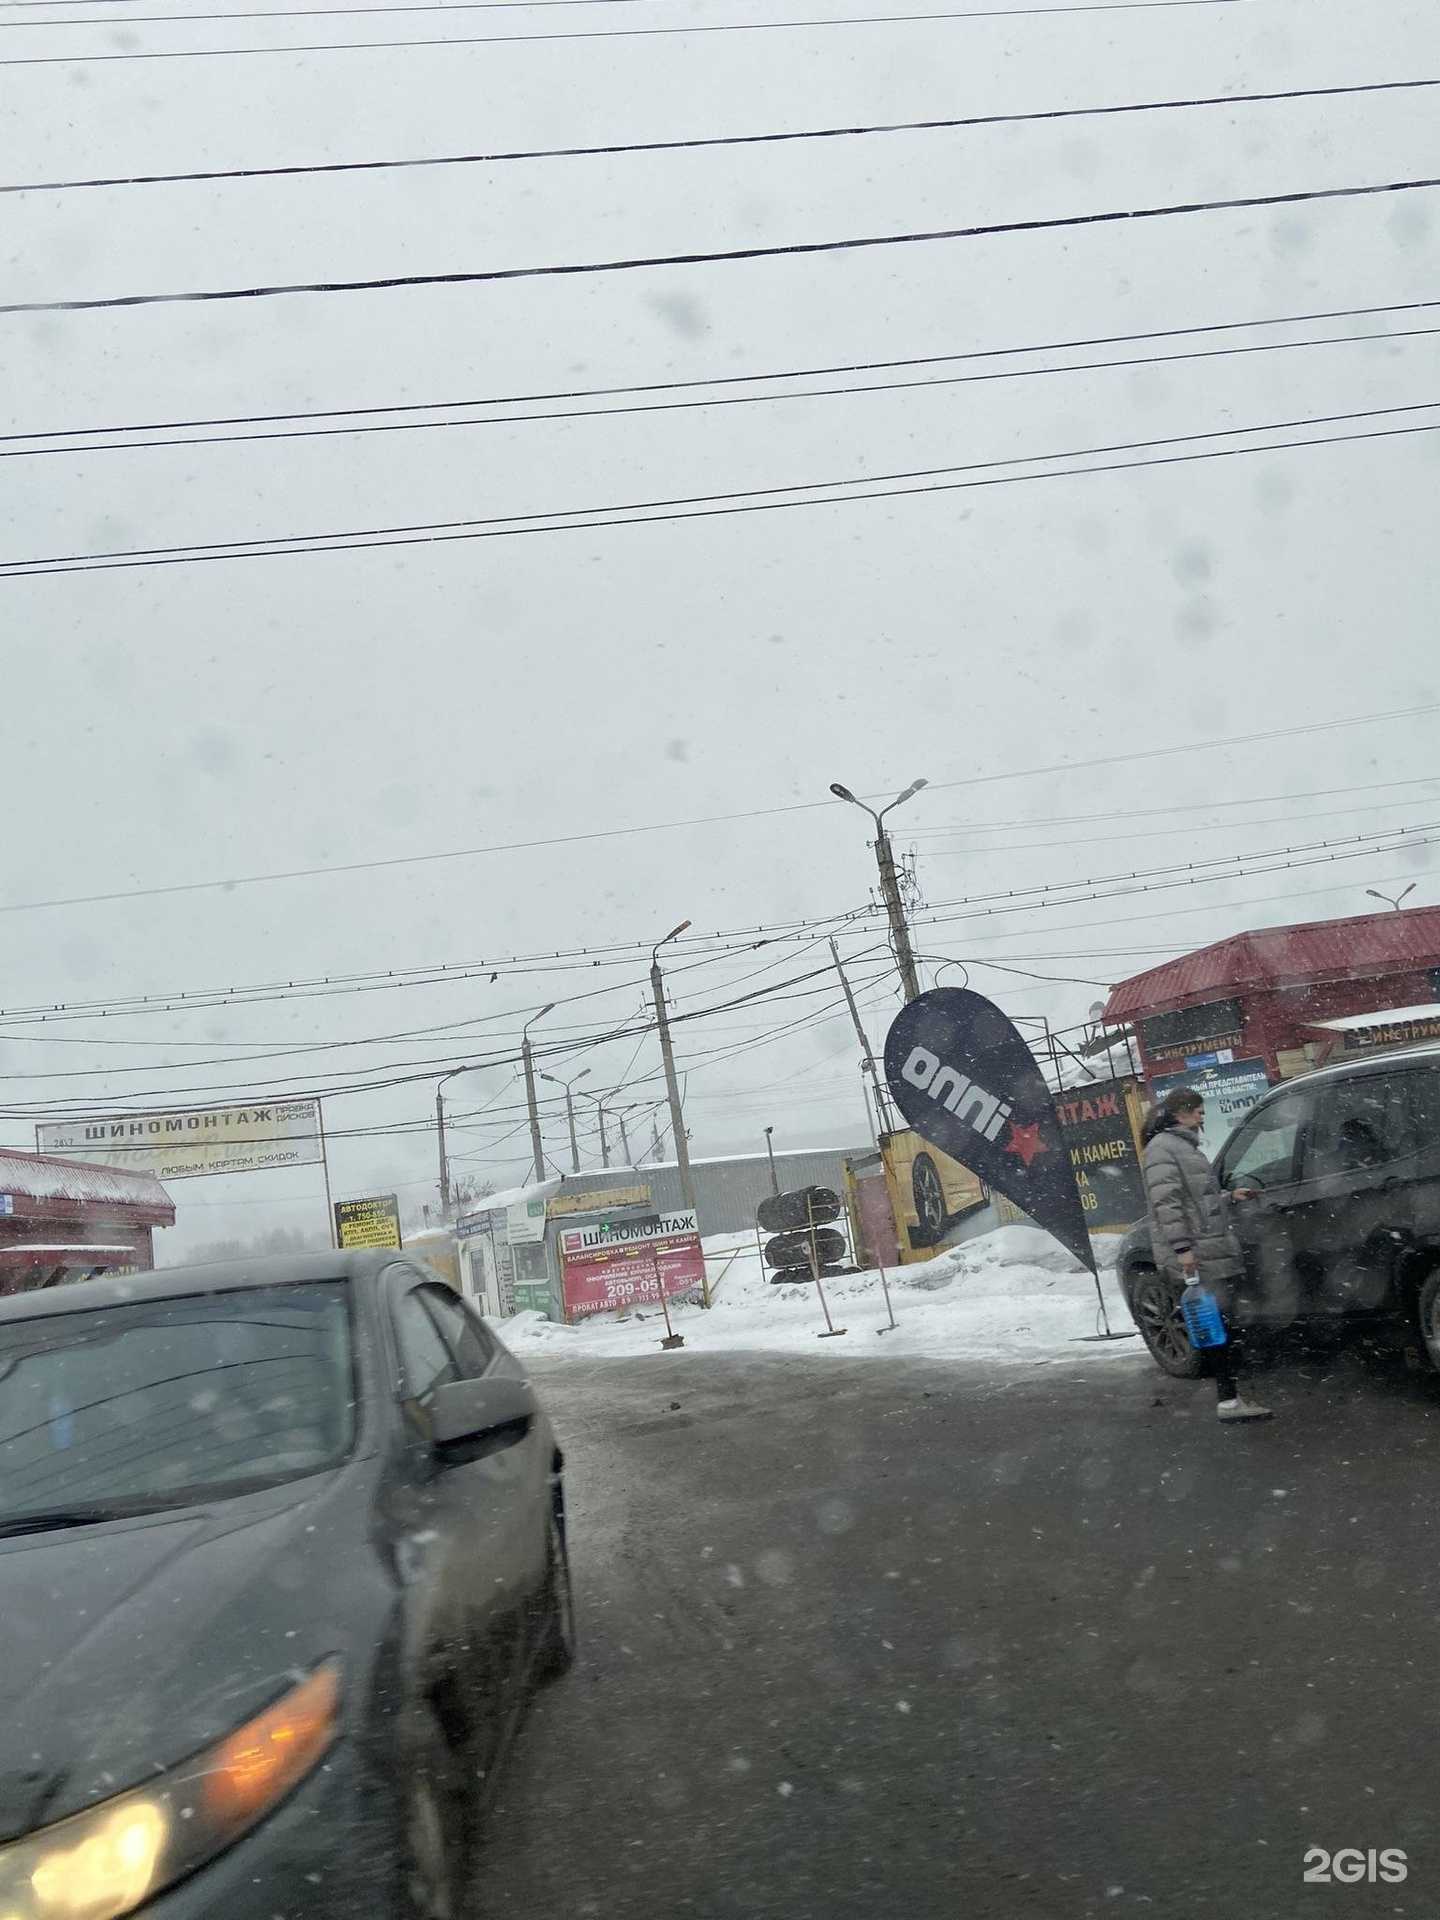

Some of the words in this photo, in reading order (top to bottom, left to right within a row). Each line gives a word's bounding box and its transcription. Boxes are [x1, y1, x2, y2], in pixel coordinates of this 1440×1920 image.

[1164, 1034, 1243, 1058] ИНСТРУМЕНТЫ
[85, 1109, 273, 1140] ШИНОМОНТАЖ
[161, 1162, 205, 1176] ЛЮБЫМ
[208, 1157, 254, 1171] КАРТАМ
[257, 1150, 299, 1164] СКИДОК
[583, 1215, 696, 1247] ШИНОМОНТАЖ
